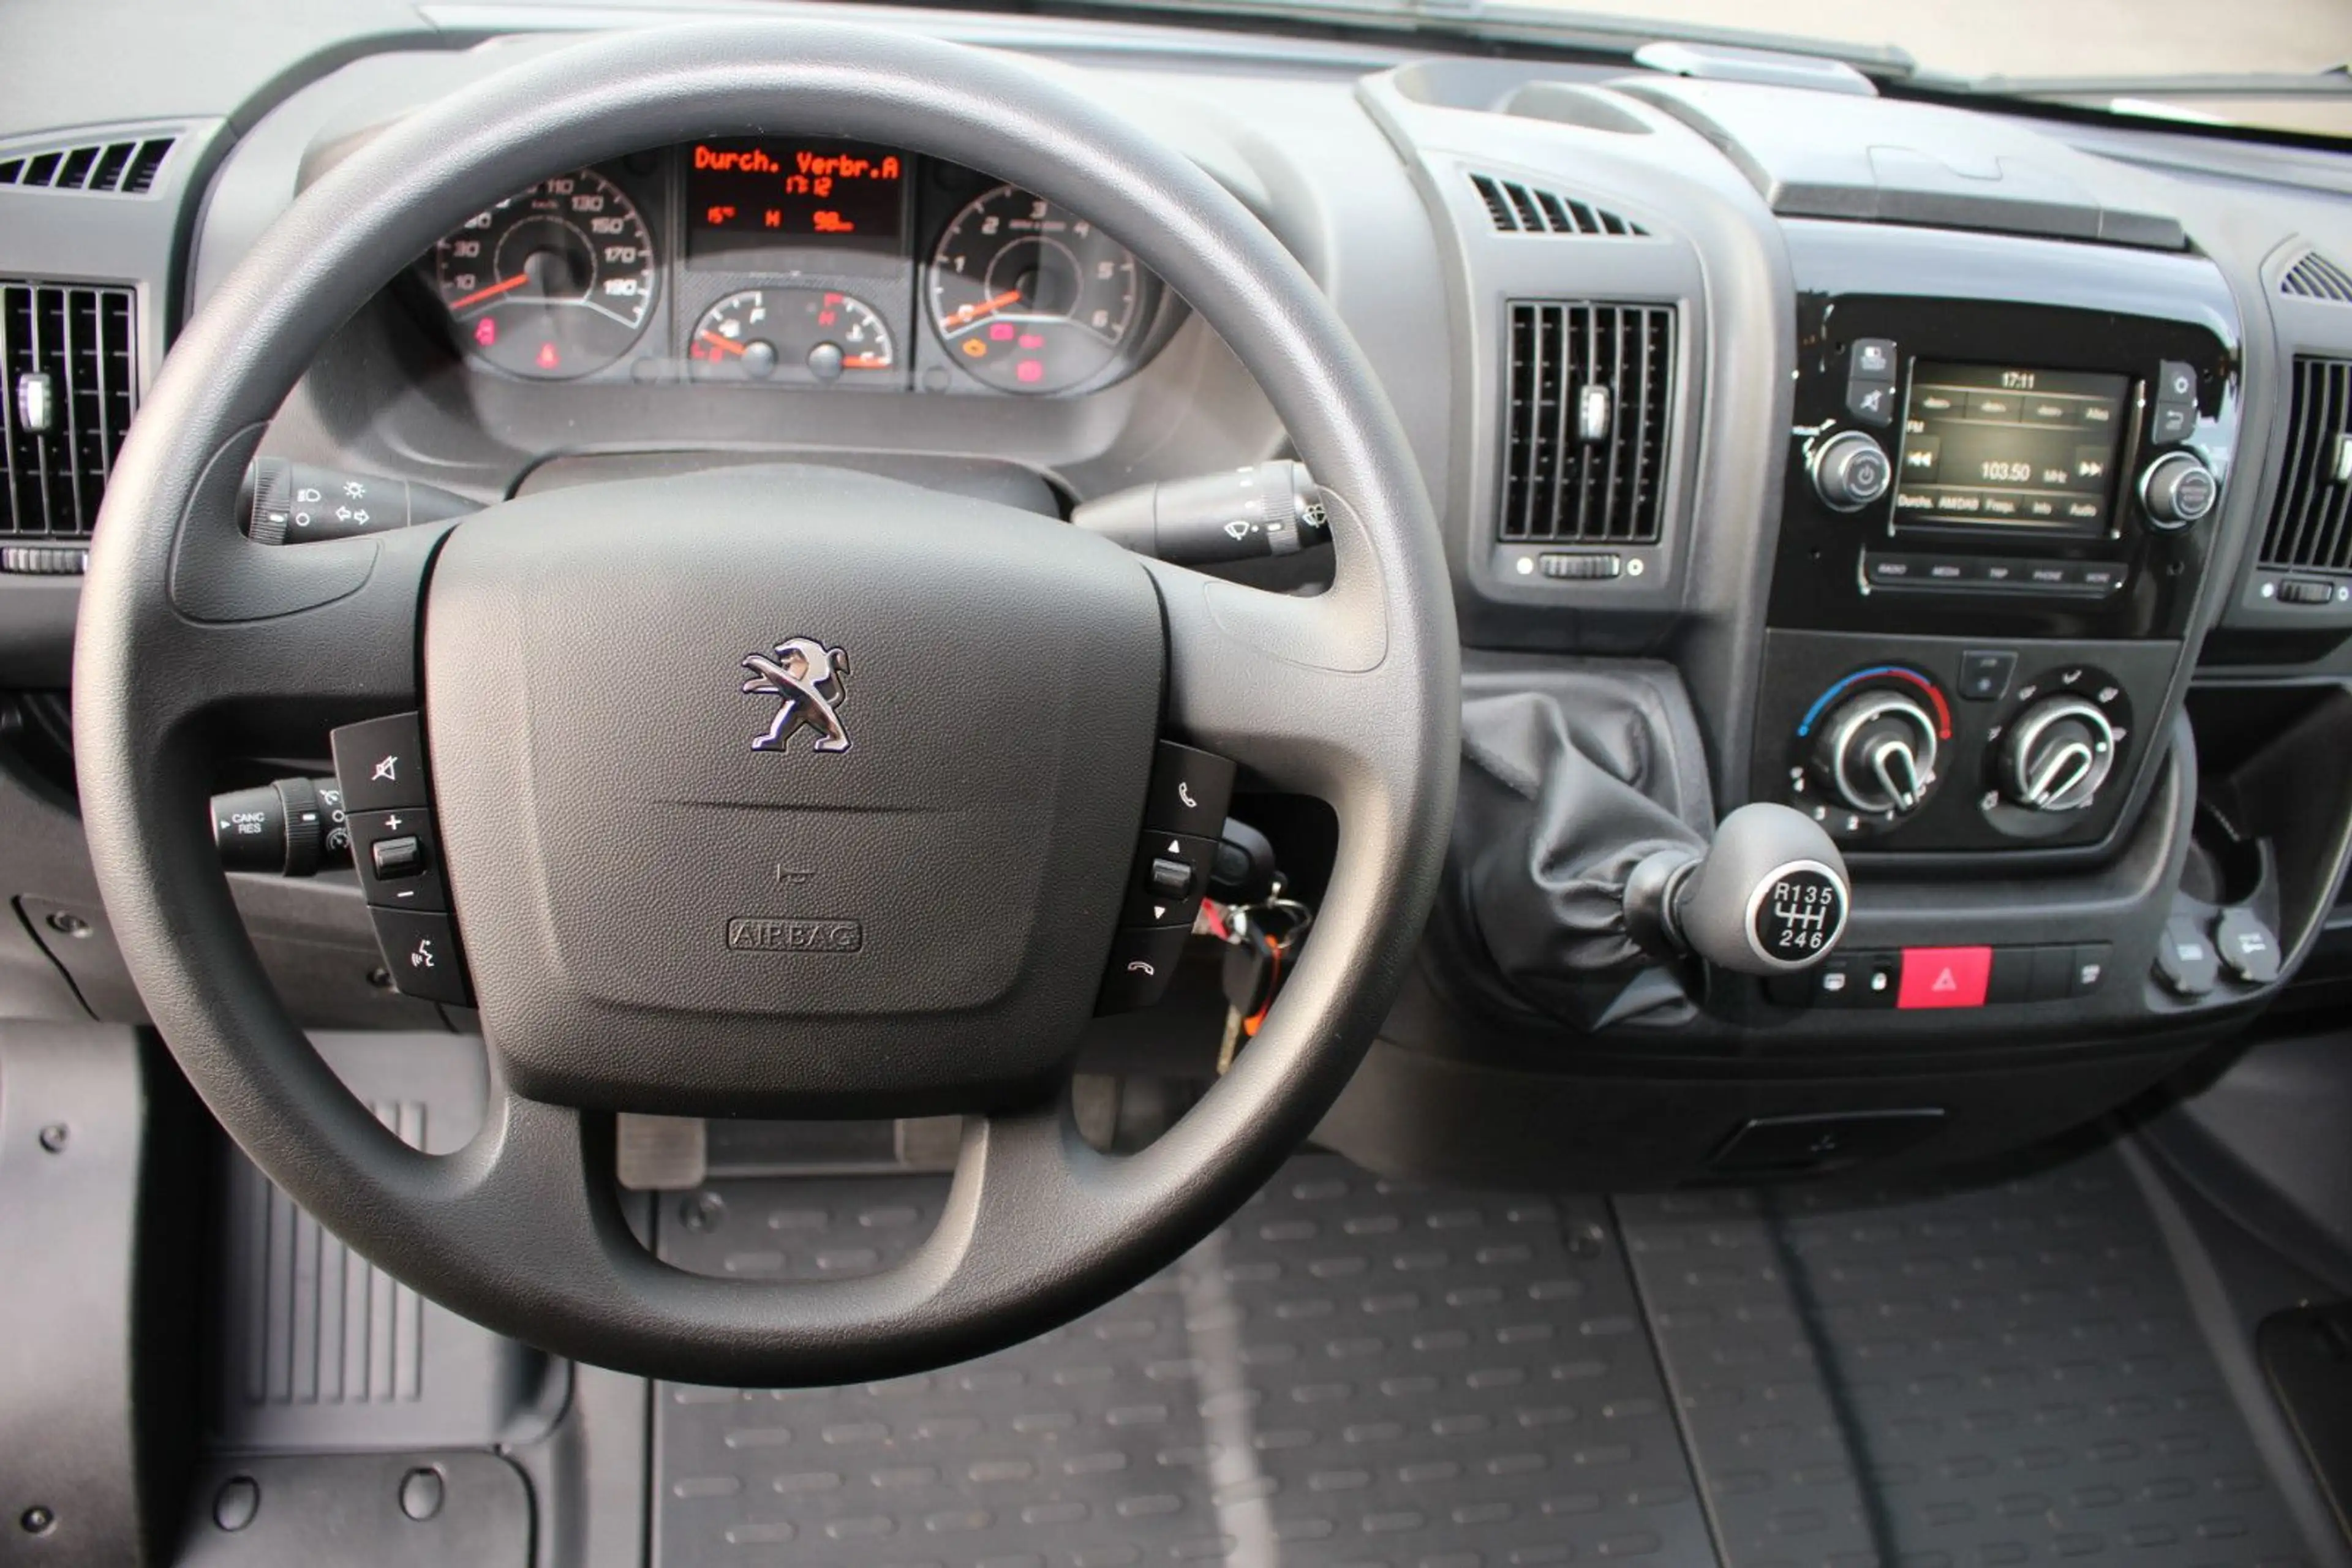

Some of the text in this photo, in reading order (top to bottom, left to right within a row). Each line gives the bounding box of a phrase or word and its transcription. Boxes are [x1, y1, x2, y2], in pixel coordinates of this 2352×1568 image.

[694, 145, 899, 179] Durch. Verbr.A
[605, 246, 636, 263] 170
[1981, 461, 2031, 481] 103.50
[232, 812, 265, 824] CANC
[238, 823, 262, 834] RES
[733, 923, 855, 946] AIRBAG
